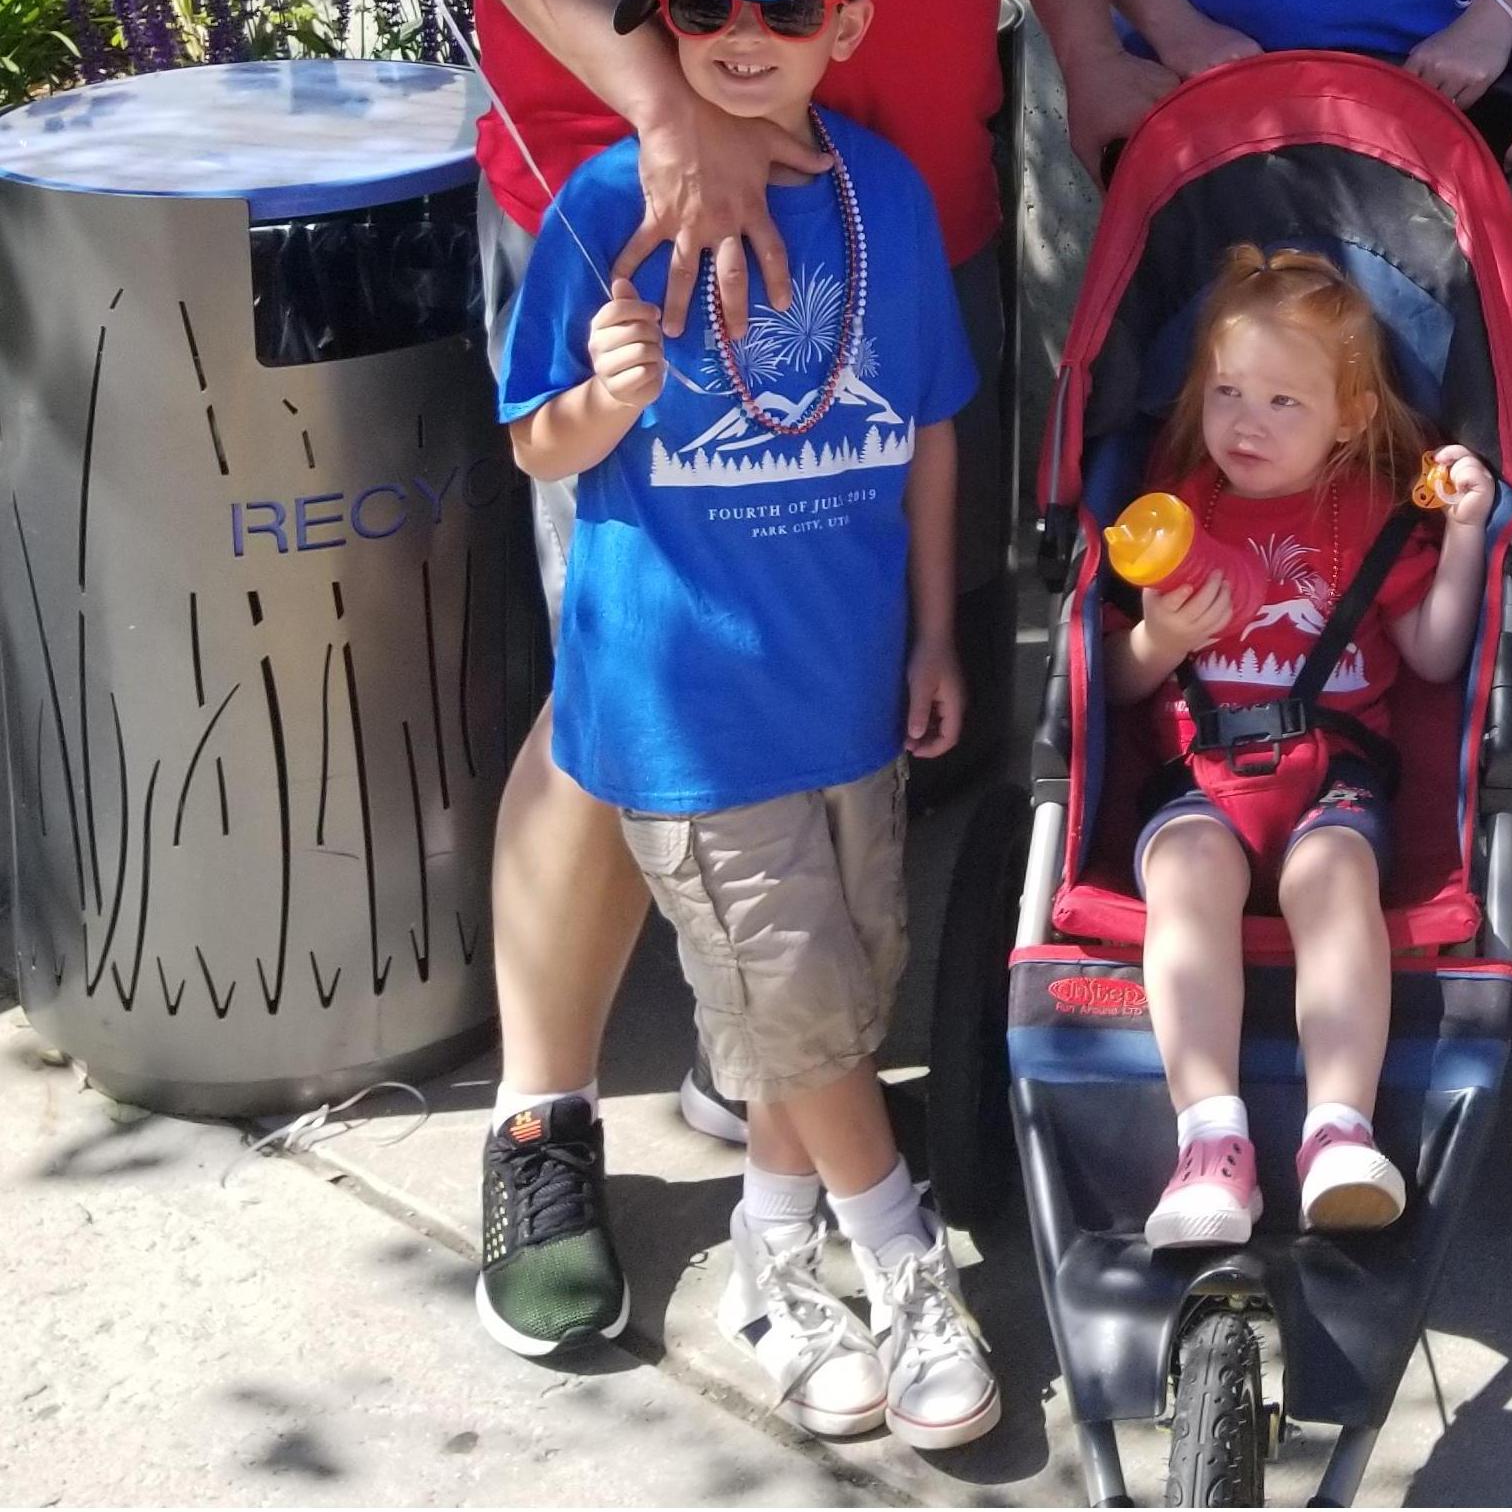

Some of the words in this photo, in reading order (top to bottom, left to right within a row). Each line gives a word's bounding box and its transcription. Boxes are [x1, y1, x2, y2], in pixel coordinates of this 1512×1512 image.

[708, 504, 781, 521] FOURTH
[788, 500, 808, 514] OF
[751, 524, 787, 538] PARK
